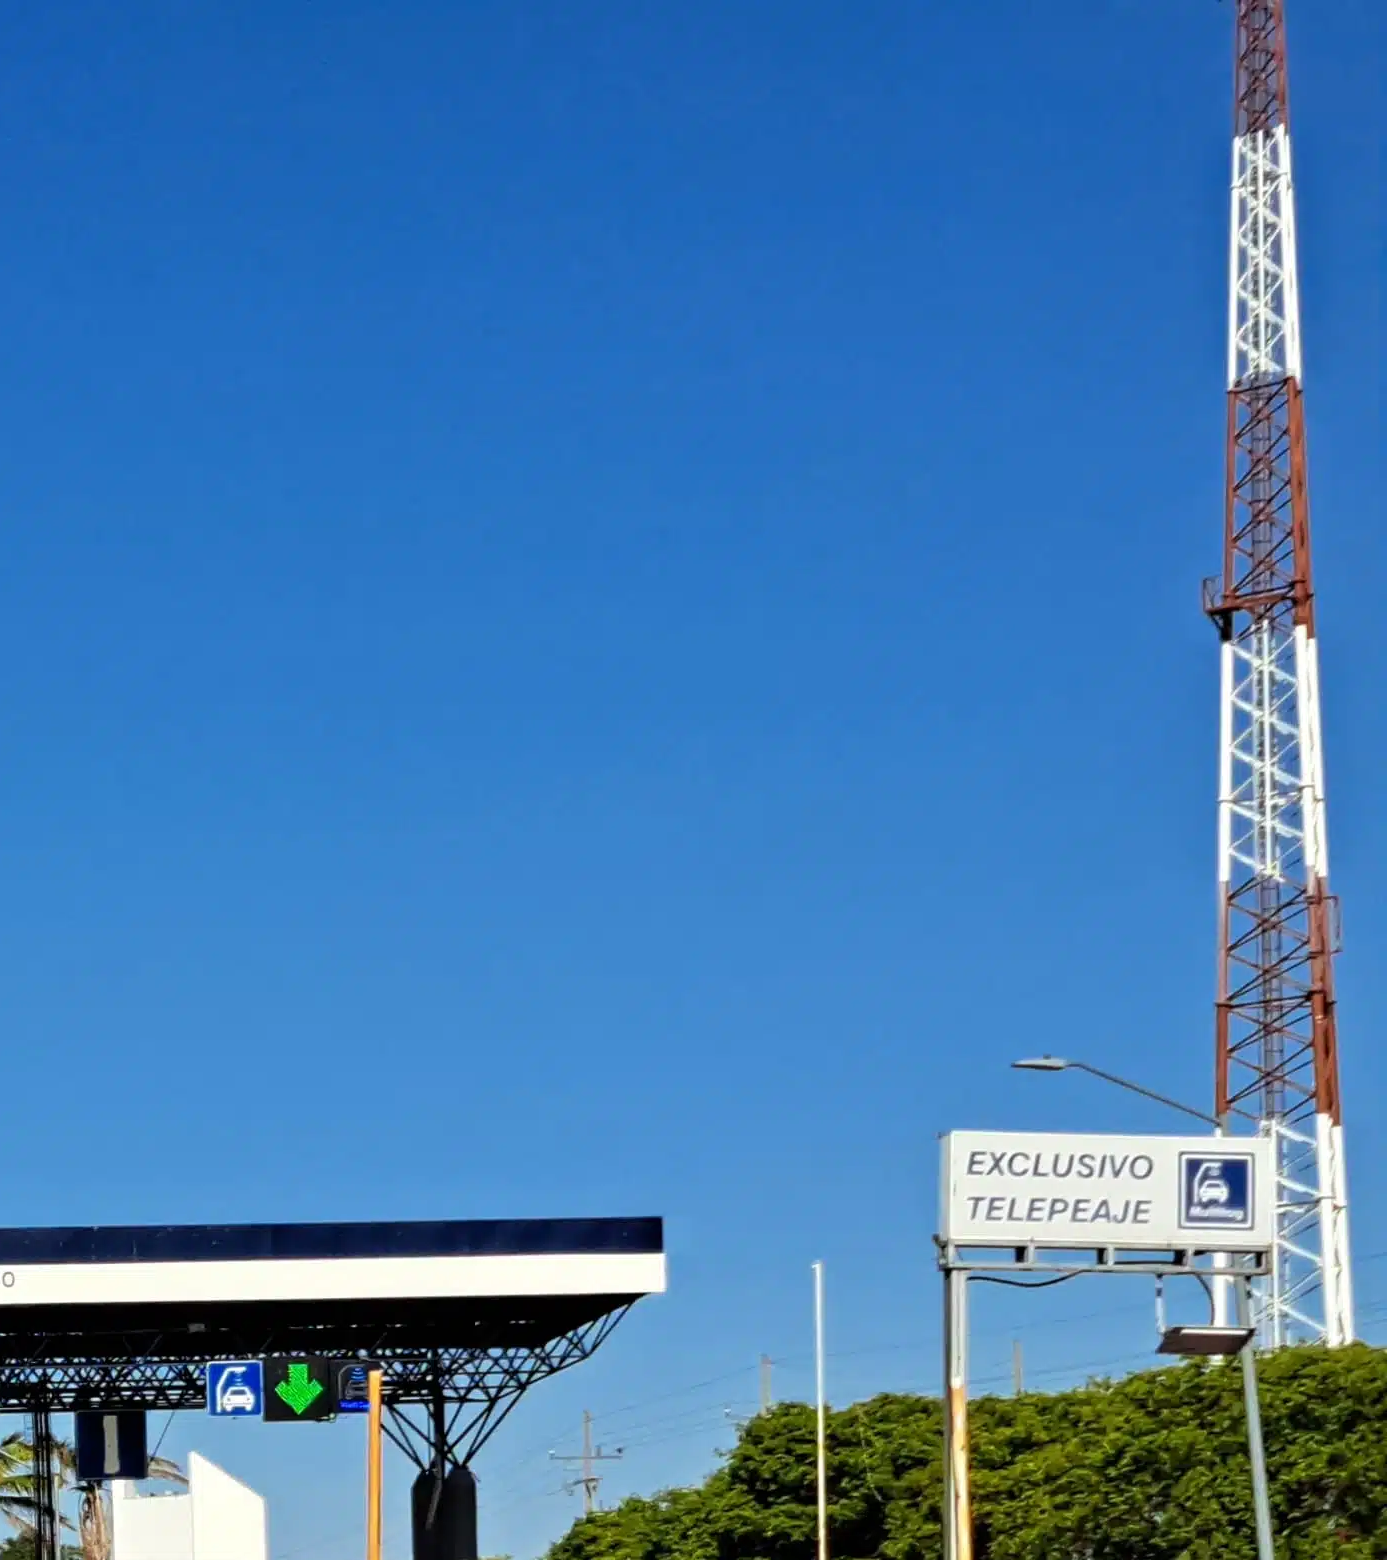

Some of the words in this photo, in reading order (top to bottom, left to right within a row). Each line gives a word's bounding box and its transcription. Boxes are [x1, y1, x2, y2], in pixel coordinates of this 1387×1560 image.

[966, 1151, 1154, 1181] EXCLUSIVO
[967, 1196, 1153, 1225] TELEPEAJE
[103, 1415, 120, 1474] 1
